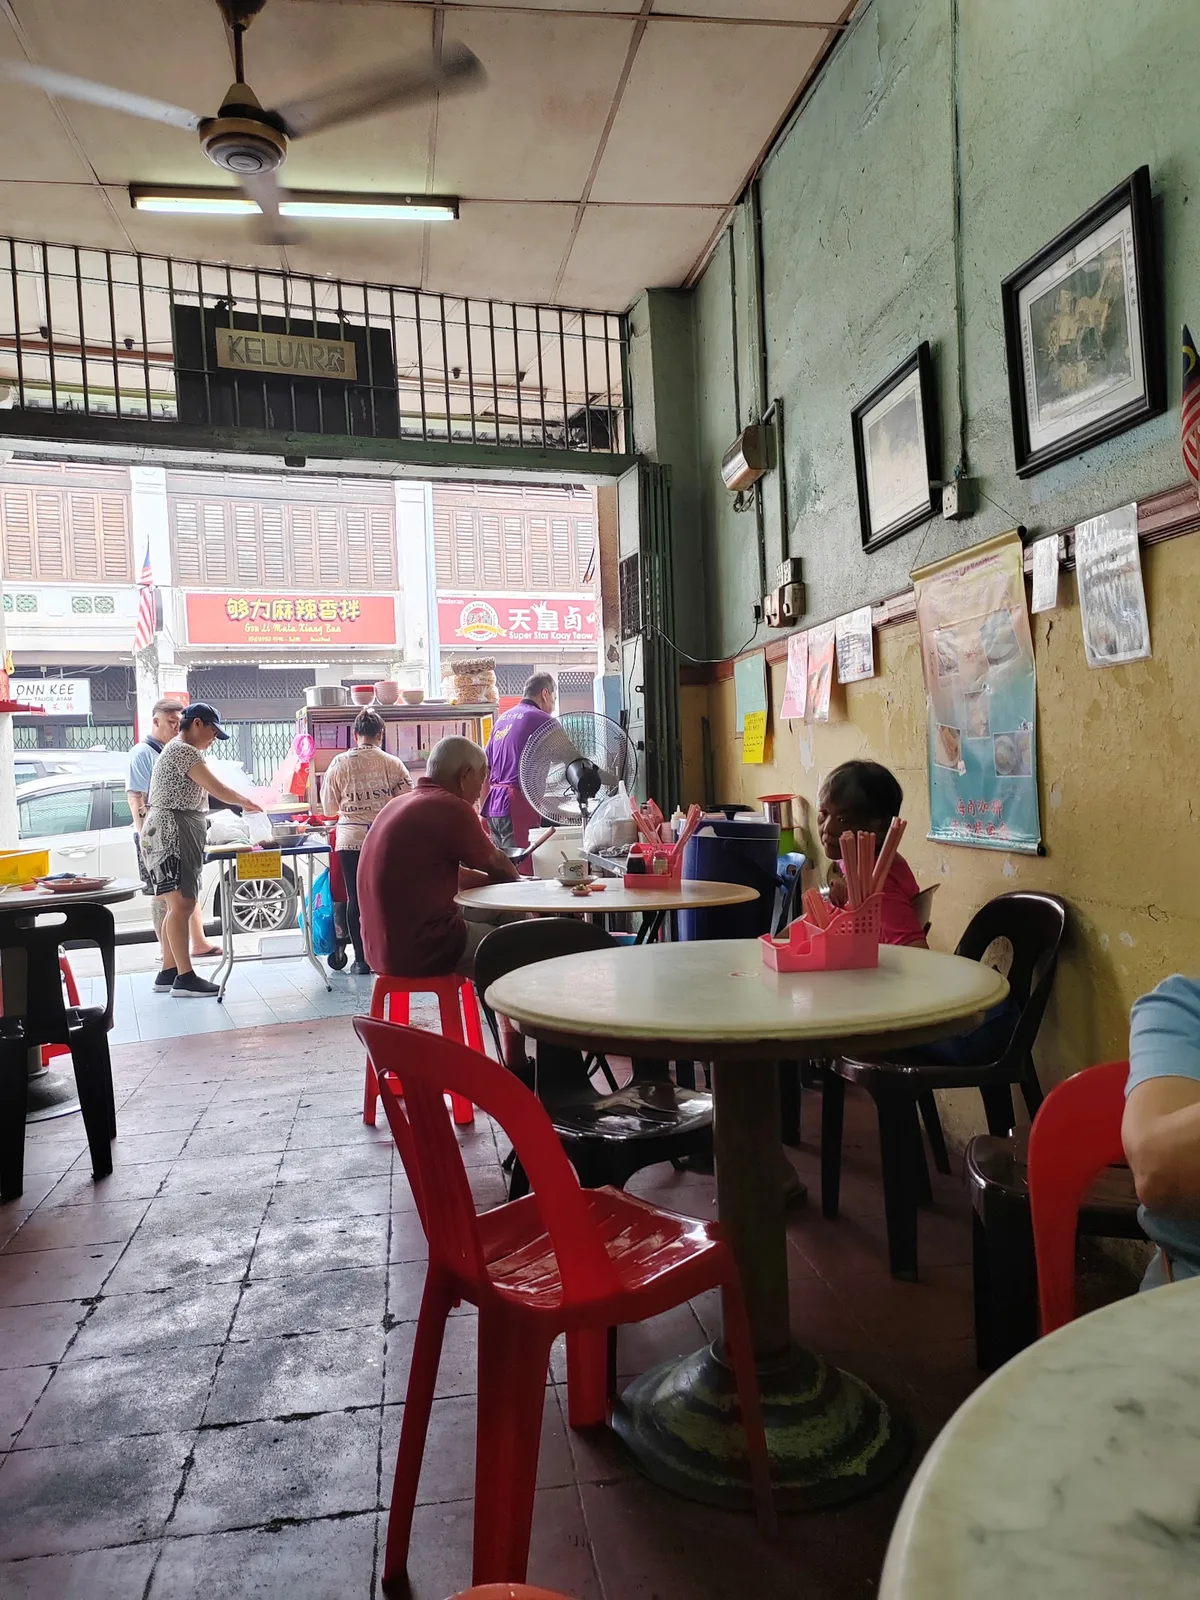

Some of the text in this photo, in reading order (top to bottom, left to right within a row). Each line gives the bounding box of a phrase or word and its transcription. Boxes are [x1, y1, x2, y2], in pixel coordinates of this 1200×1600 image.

[228, 335, 325, 371] KELUAR
[226, 597, 360, 622] 够力麻辣香拌
[509, 632, 532, 640] Super
[551, 632, 571, 641] Koay
[573, 632, 593, 640] Teow
[16, 683, 45, 696] ONN
[49, 683, 75, 695] KEE
